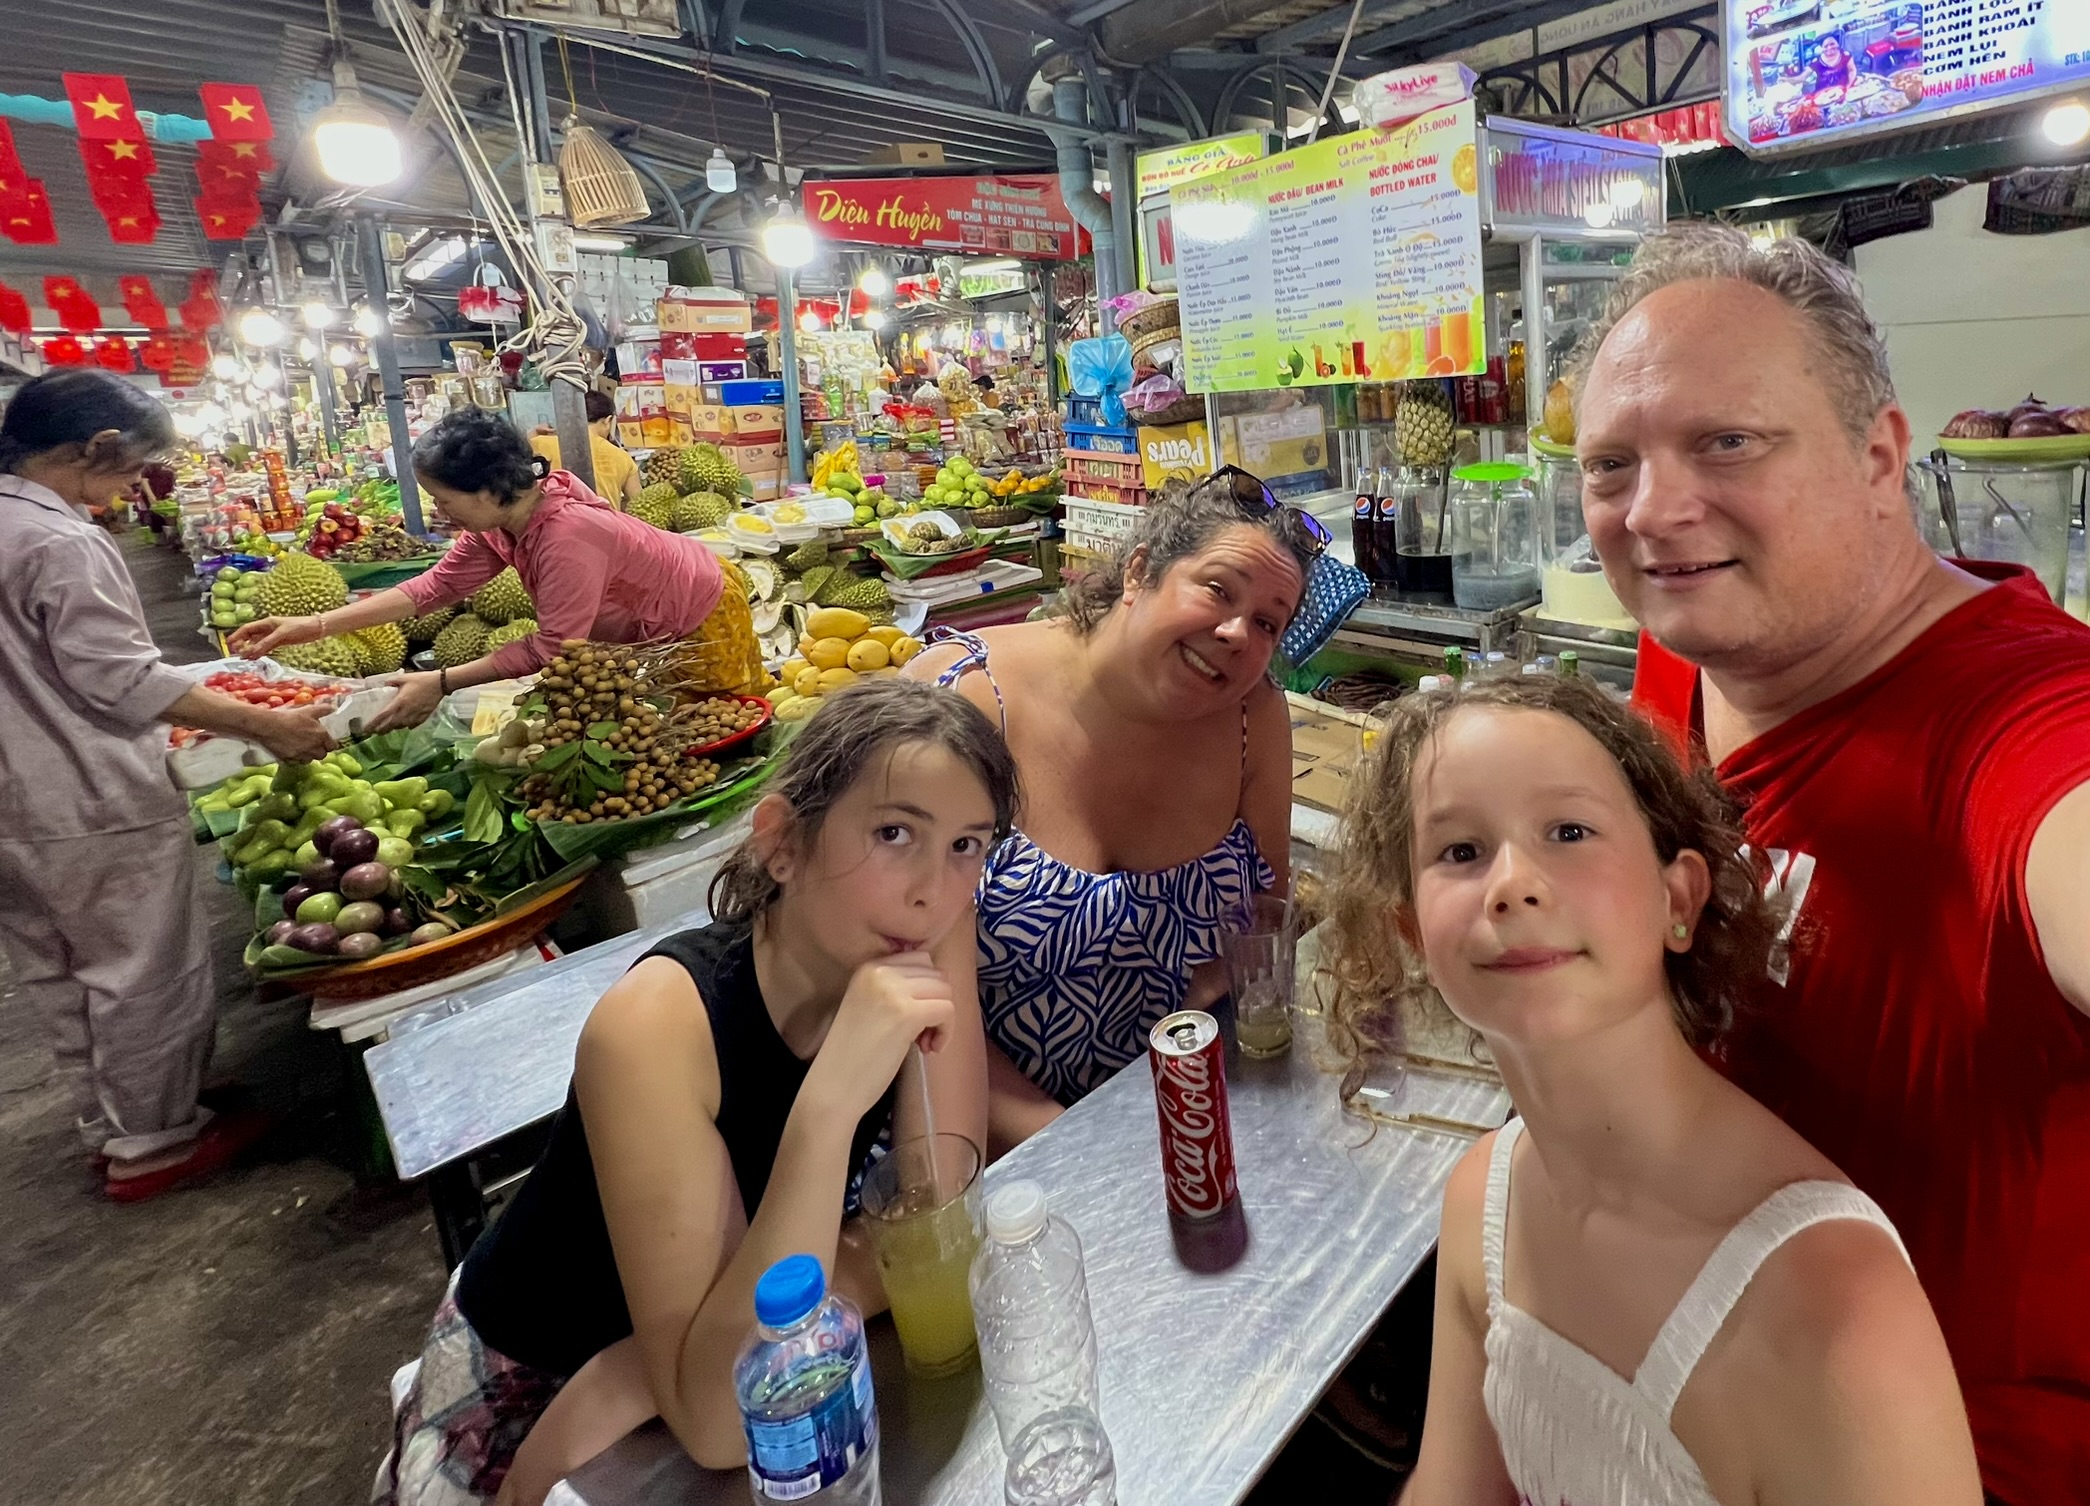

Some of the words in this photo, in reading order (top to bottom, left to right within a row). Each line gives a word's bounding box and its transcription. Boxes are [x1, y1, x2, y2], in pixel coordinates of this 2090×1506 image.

[1978, 7, 2020, 25] RAM
[1924, 47, 1963, 63] NEM
[1980, 68, 2006, 86] NEM
[1305, 182, 1324, 195] BEAN
[1326, 178, 1344, 190] MILK
[1370, 181, 1405, 197] BOTTLED
[1407, 172, 1437, 188] WATER
[816, 189, 870, 231] Diệu
[876, 195, 943, 241] Huyền
[1434, 259, 1465, 271] 10.000Đ
[1435, 282, 1466, 294] 10.000Đ
[1436, 304, 1467, 315] 10.000Đ
[1147, 437, 1206, 468] Pears
[1156, 1052, 1222, 1220] Coca-Cola
